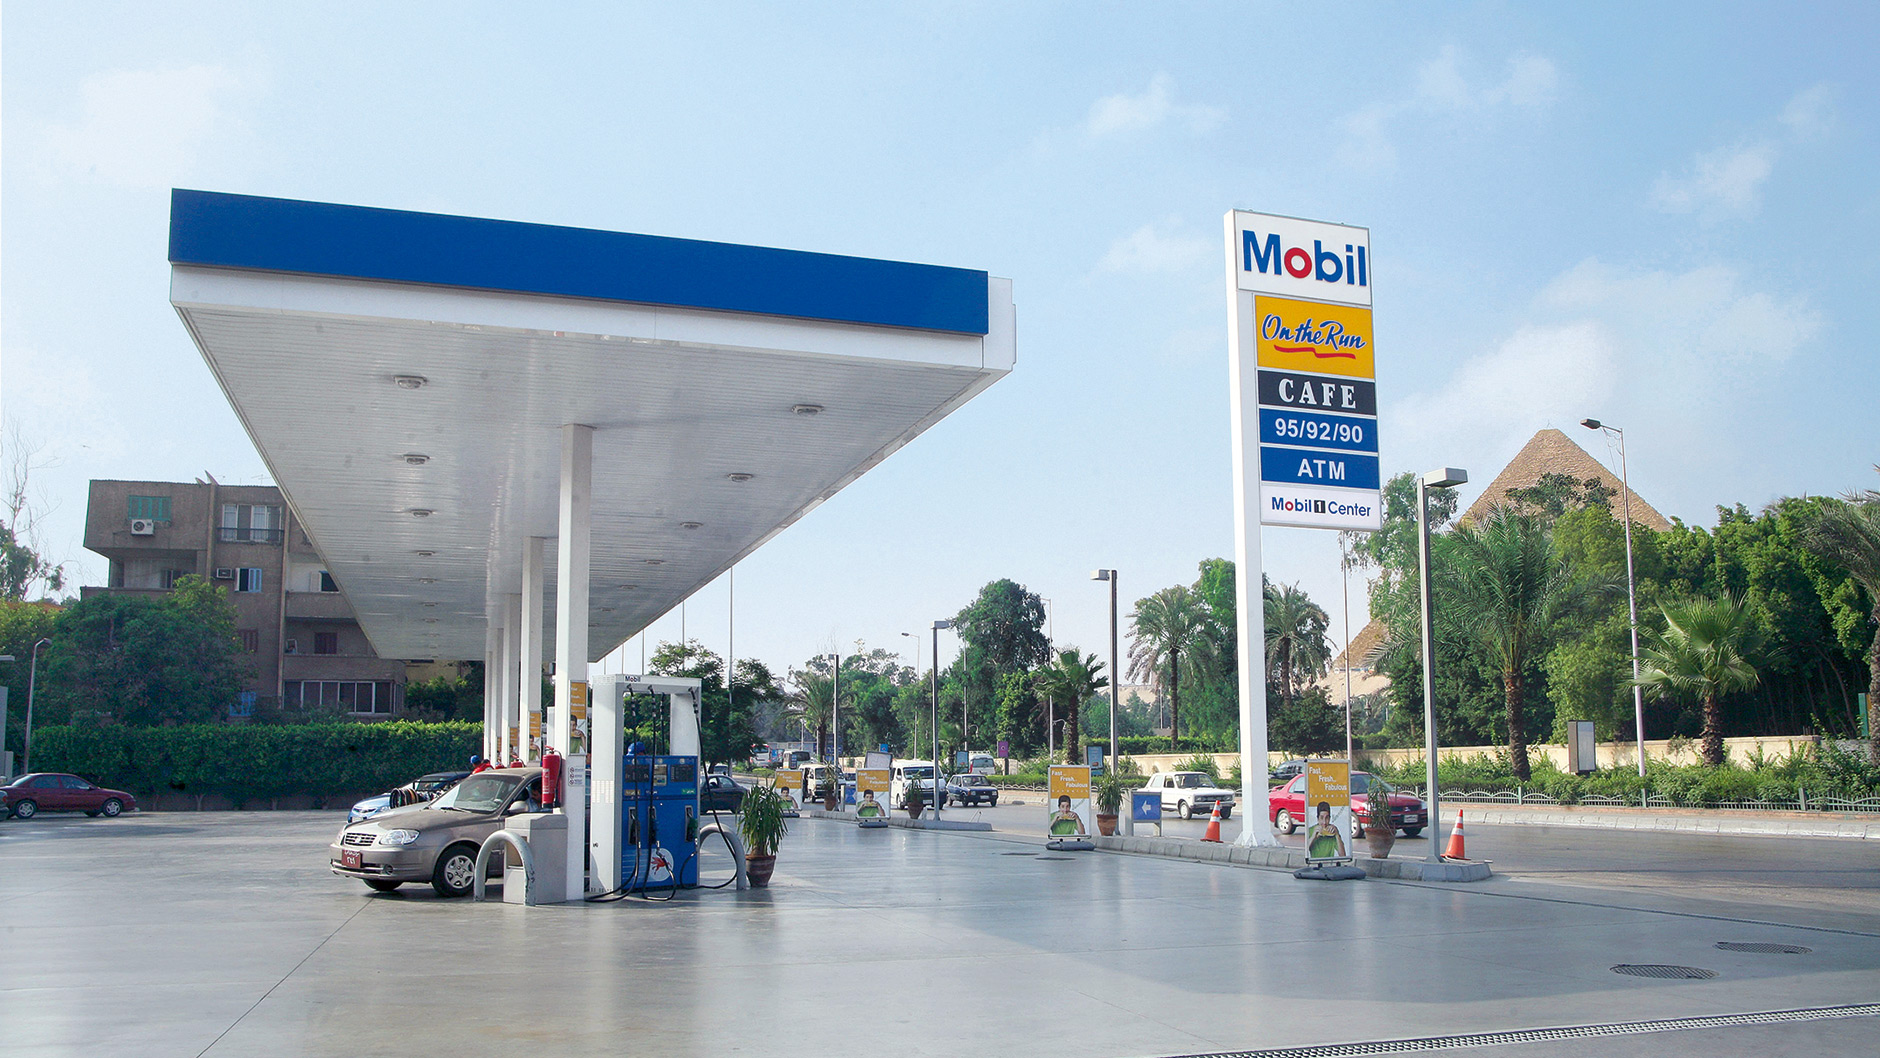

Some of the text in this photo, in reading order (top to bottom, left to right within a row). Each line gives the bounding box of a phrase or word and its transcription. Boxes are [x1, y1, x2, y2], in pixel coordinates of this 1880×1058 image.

[1242, 229, 1367, 287] Mobil
[1262, 313, 1367, 351] On the Run
[1278, 378, 1356, 409] CAFE
[1275, 418, 1363, 444] 95/92/90
[1297, 458, 1346, 480] ATM
[1271, 496, 1312, 513] Mobil
[1328, 501, 1371, 517] Center
